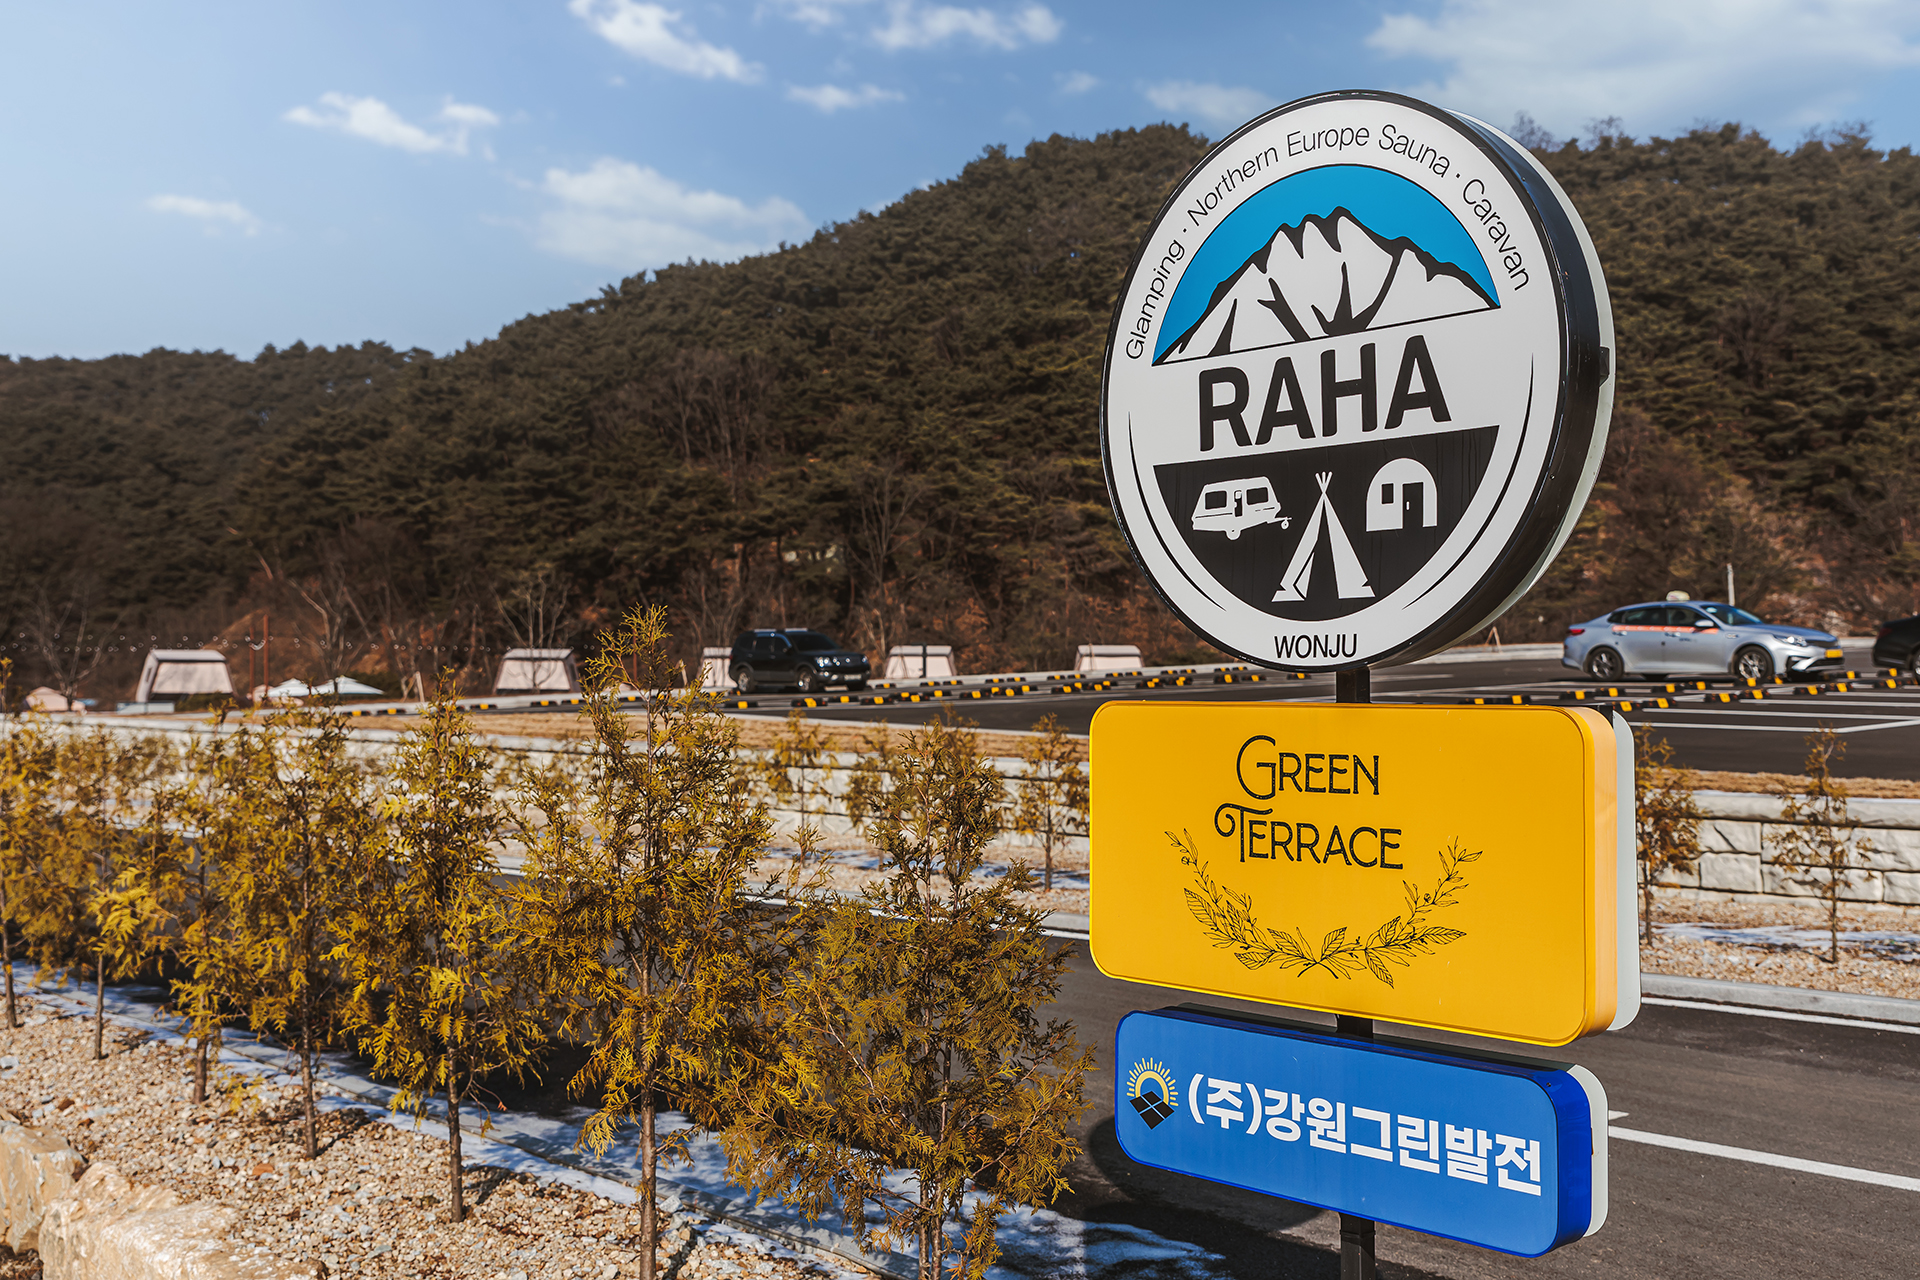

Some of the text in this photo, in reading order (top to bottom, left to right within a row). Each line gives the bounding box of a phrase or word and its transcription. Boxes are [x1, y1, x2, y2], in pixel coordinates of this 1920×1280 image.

[1125, 124, 1531, 360] Glamping Northern Europe Sauna Caravan
[1198, 335, 1452, 452] RAHA
[1274, 634, 1358, 660] WONJU
[1236, 734, 1380, 800] GREEN
[1213, 802, 1404, 869] TERRACE
[1188, 1073, 1542, 1197] (주)강원그린발전
